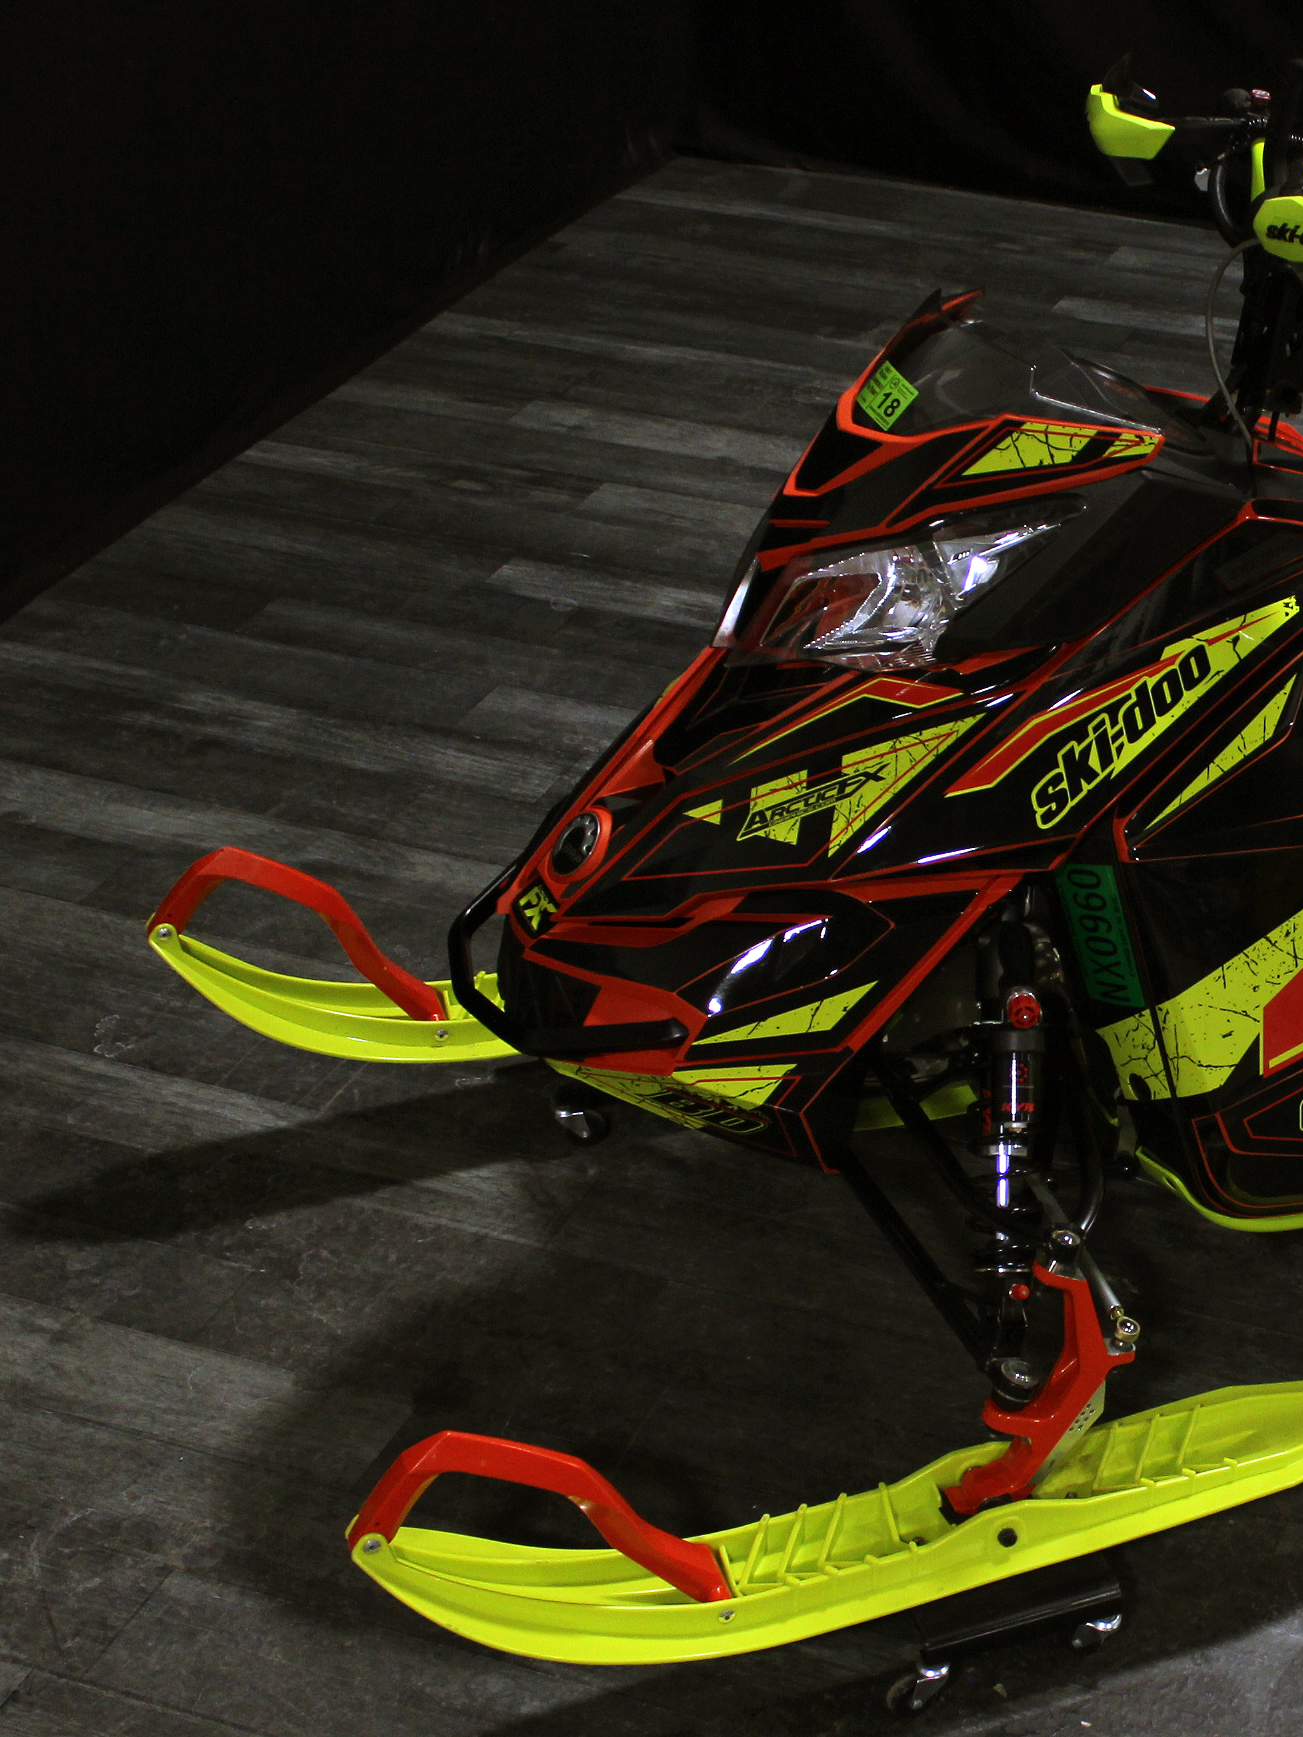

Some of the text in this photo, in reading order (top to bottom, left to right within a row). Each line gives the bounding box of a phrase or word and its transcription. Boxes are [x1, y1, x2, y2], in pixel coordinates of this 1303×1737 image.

[877, 392, 901, 417] 18
[1031, 643, 1212, 829] ski-doo
[1067, 868, 1132, 1003] NX0960
